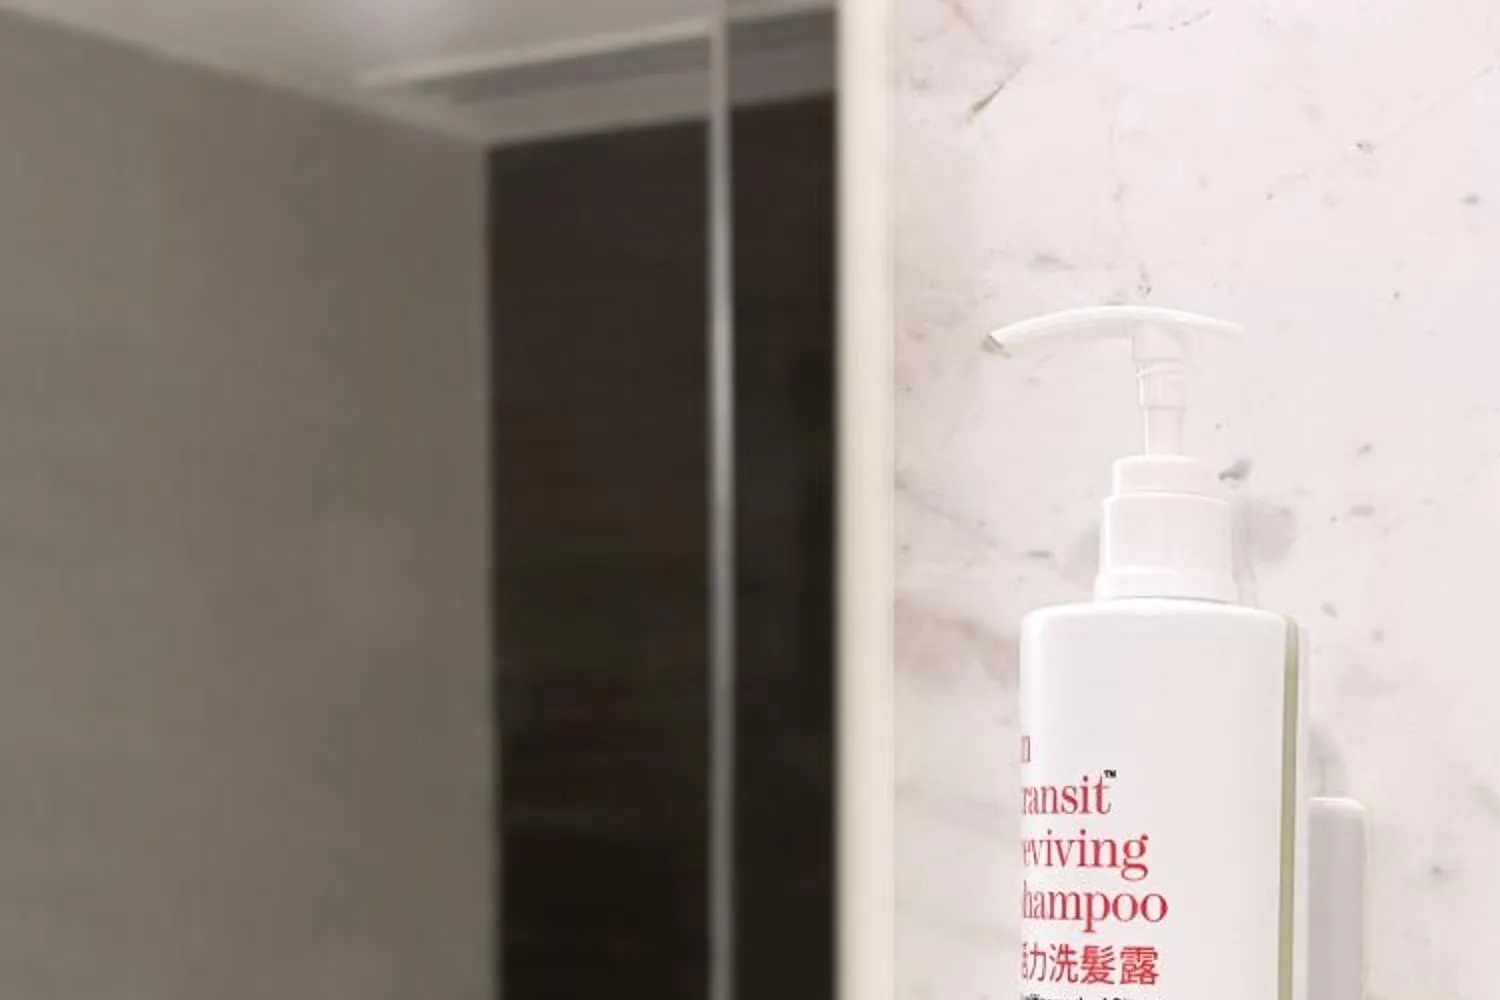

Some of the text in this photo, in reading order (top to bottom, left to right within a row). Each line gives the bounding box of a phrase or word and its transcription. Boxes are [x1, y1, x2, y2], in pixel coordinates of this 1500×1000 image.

[1021, 735, 1032, 764] n
[1022, 828, 1150, 881] eviving
[1022, 880, 1168, 933] hampoo
[1022, 943, 1159, 985] 力洗髮露
